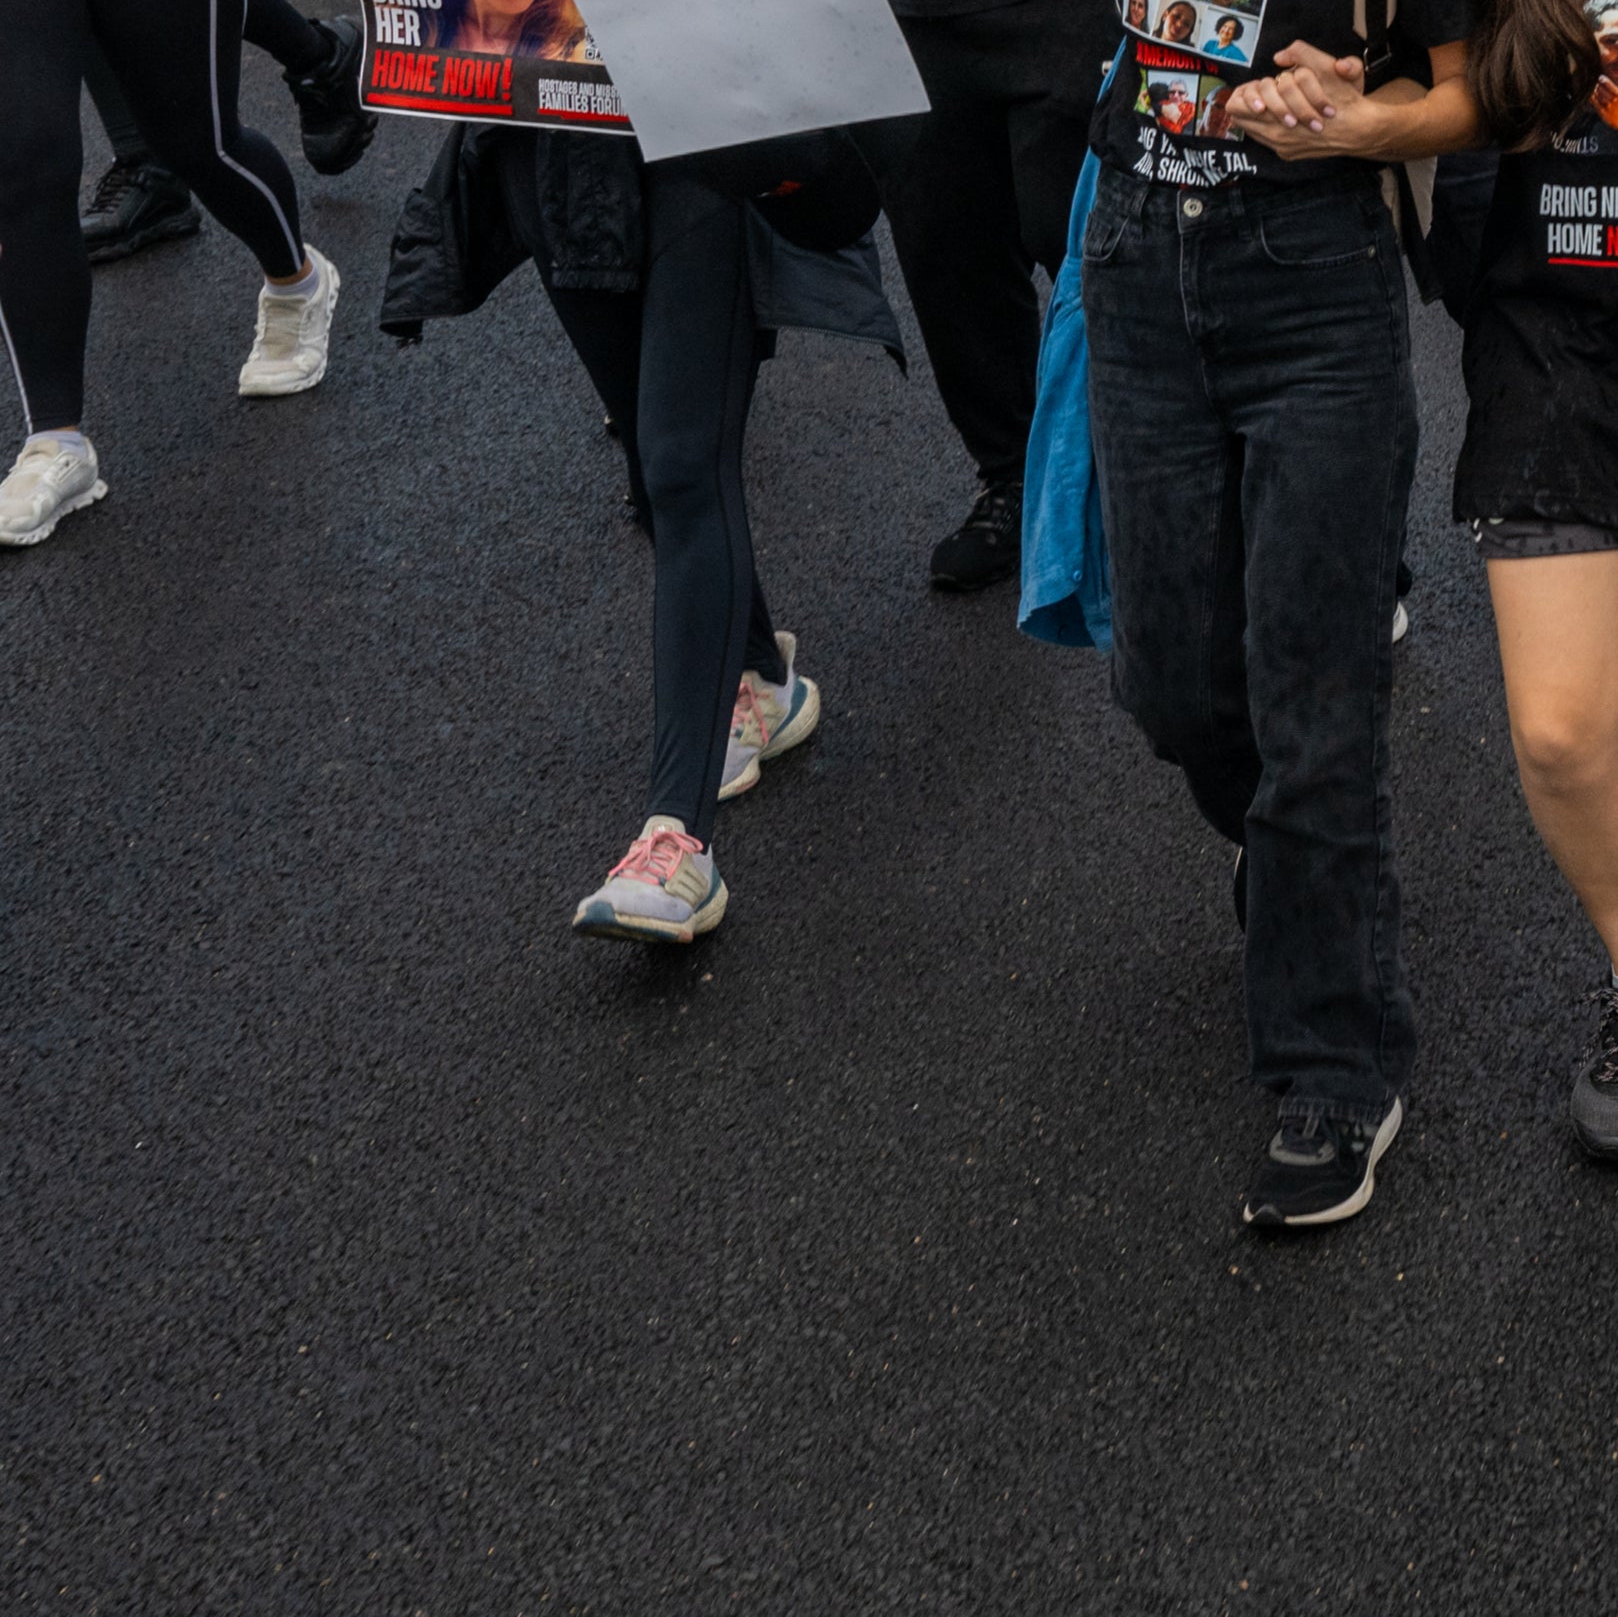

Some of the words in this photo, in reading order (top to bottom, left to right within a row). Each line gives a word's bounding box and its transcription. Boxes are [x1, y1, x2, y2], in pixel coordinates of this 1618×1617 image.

[376, 6, 421, 47] HER
[371, 49, 440, 93] HOME
[443, 58, 513, 101] NOW!
[538, 78, 578, 97] HOSTAGES
[578, 84, 595, 96] AND
[538, 91, 588, 113] FAMILIES
[1223, 151, 1258, 175] TAL,
[1539, 183, 1597, 218] BRING
[1547, 222, 1603, 257] HOME
